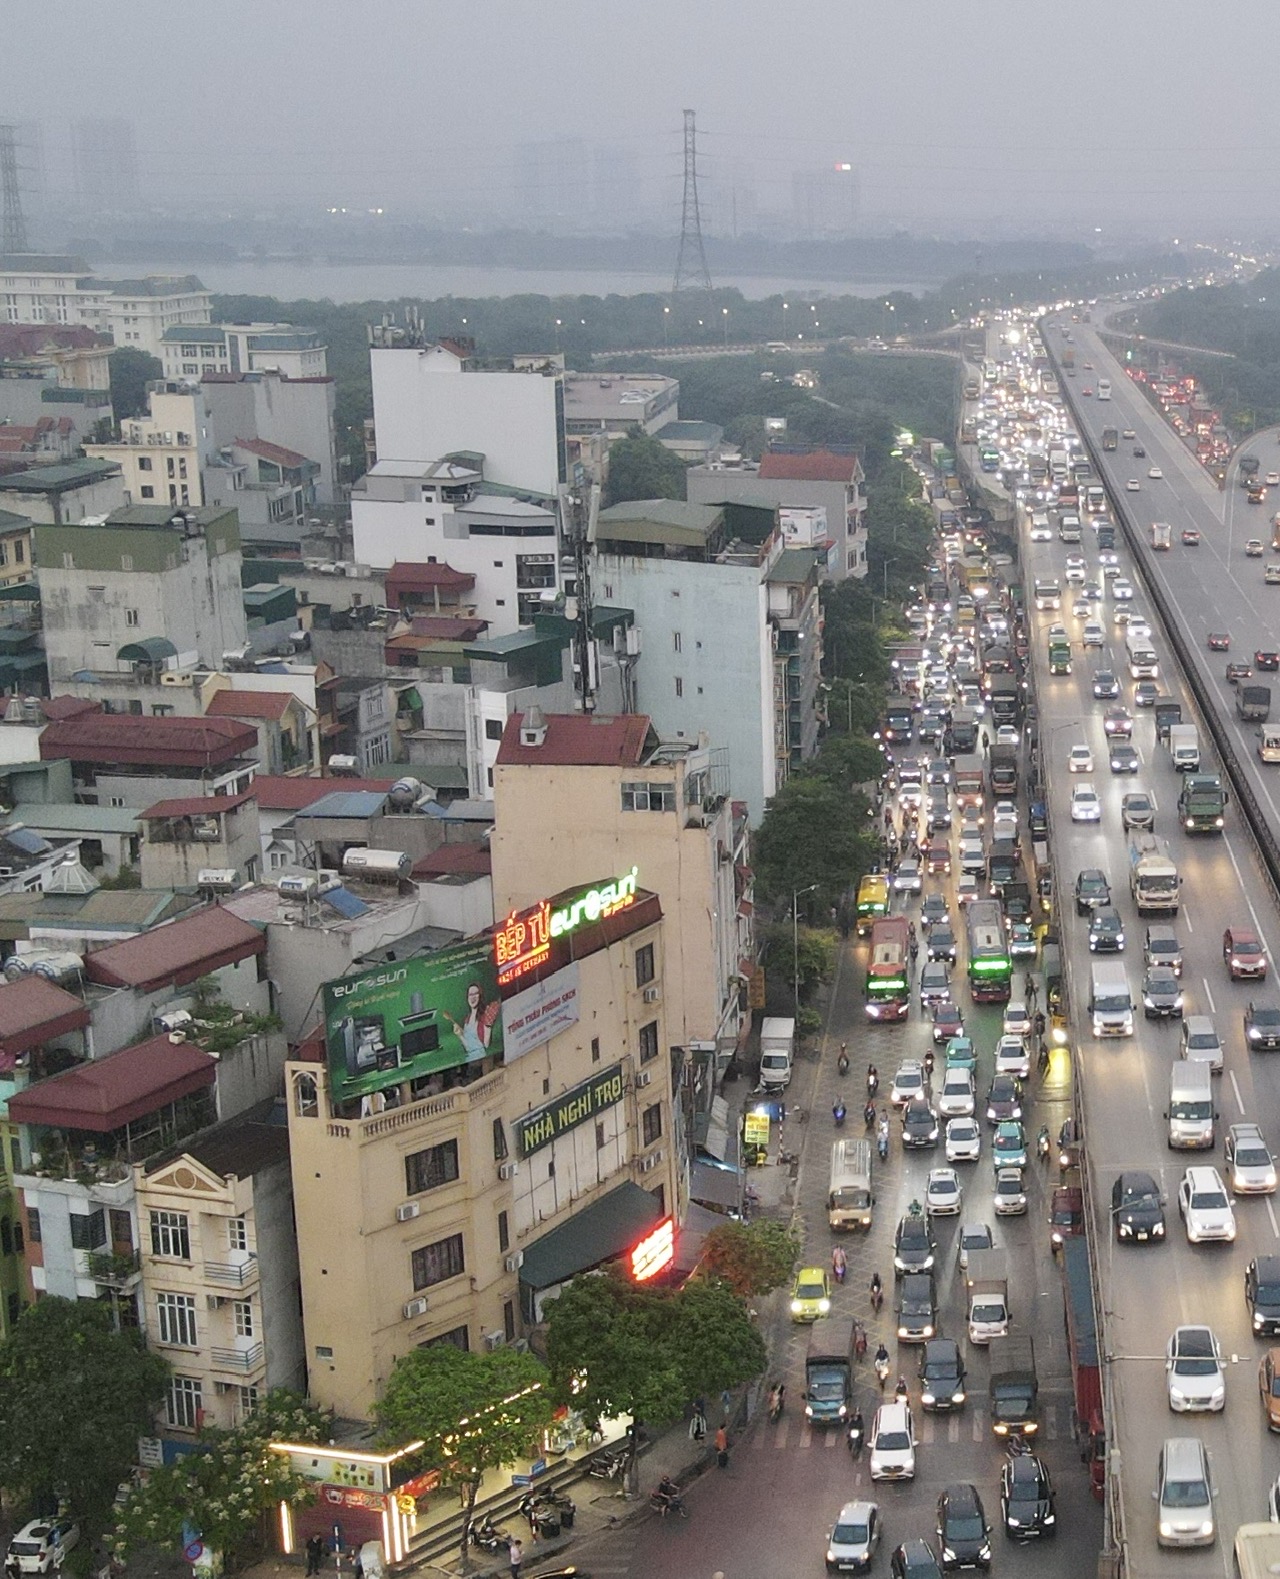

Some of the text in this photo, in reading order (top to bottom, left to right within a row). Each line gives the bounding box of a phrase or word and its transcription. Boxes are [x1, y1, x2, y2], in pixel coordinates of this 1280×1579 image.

[524, 1075, 621, 1152] NHÀ NGHỈ TRỌ
